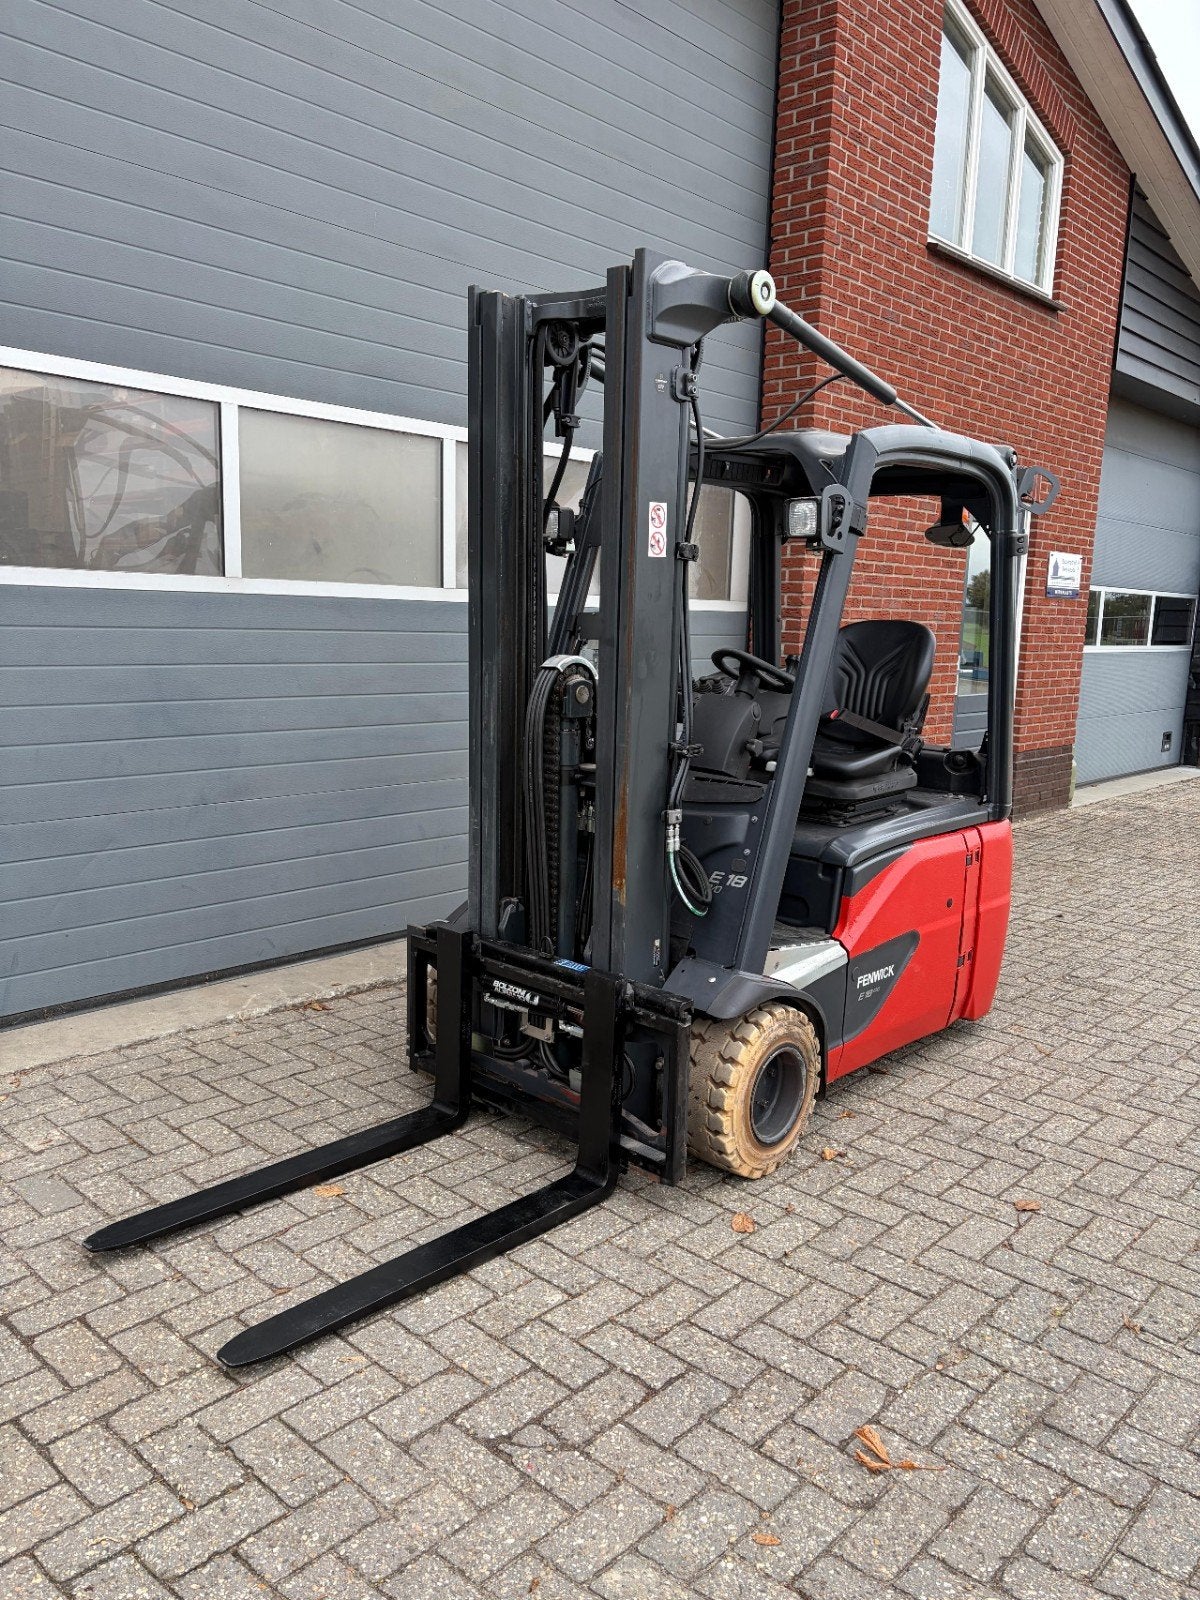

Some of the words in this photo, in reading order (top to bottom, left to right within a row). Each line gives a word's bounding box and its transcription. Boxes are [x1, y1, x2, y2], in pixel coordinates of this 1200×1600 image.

[709, 871, 725, 884] E
[726, 874, 748, 888] 18
[857, 965, 894, 989] FENWICK
